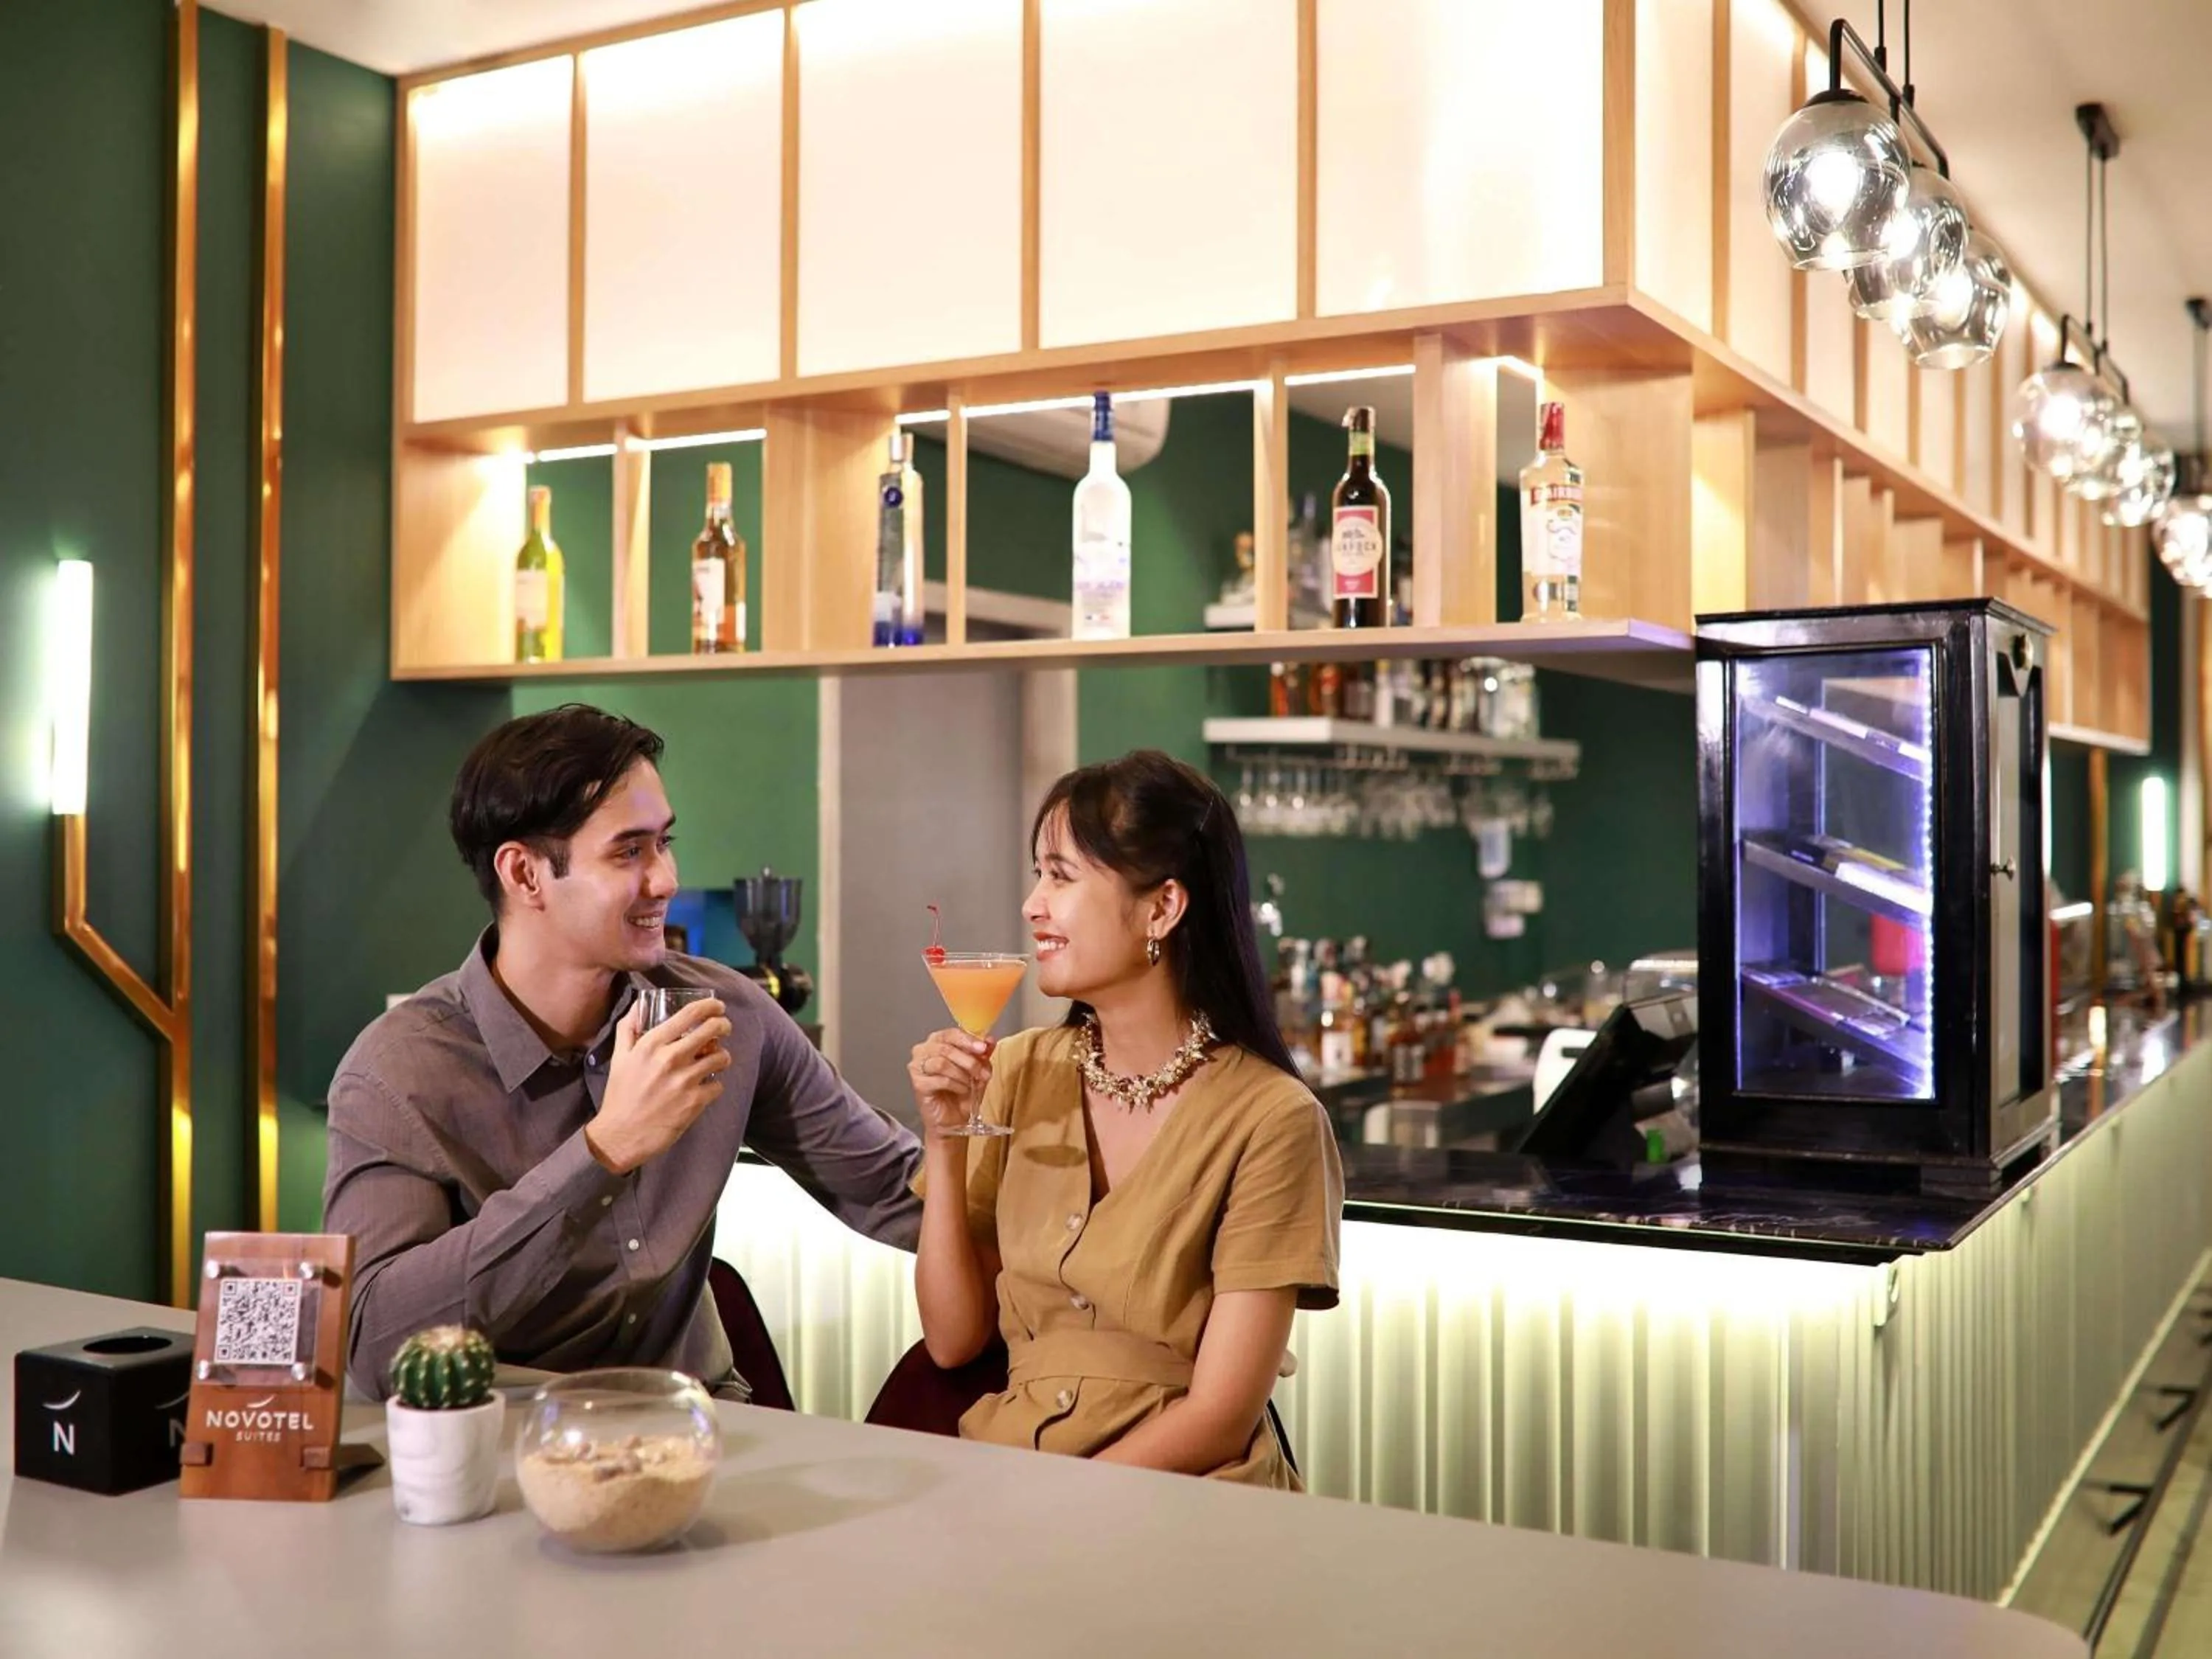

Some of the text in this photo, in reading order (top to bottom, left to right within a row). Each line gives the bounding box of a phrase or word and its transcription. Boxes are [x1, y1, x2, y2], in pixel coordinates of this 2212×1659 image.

[206, 1410, 314, 1430] NOVOTEL
[53, 1420, 74, 1455] N
[235, 1430, 282, 1442] SUITES
